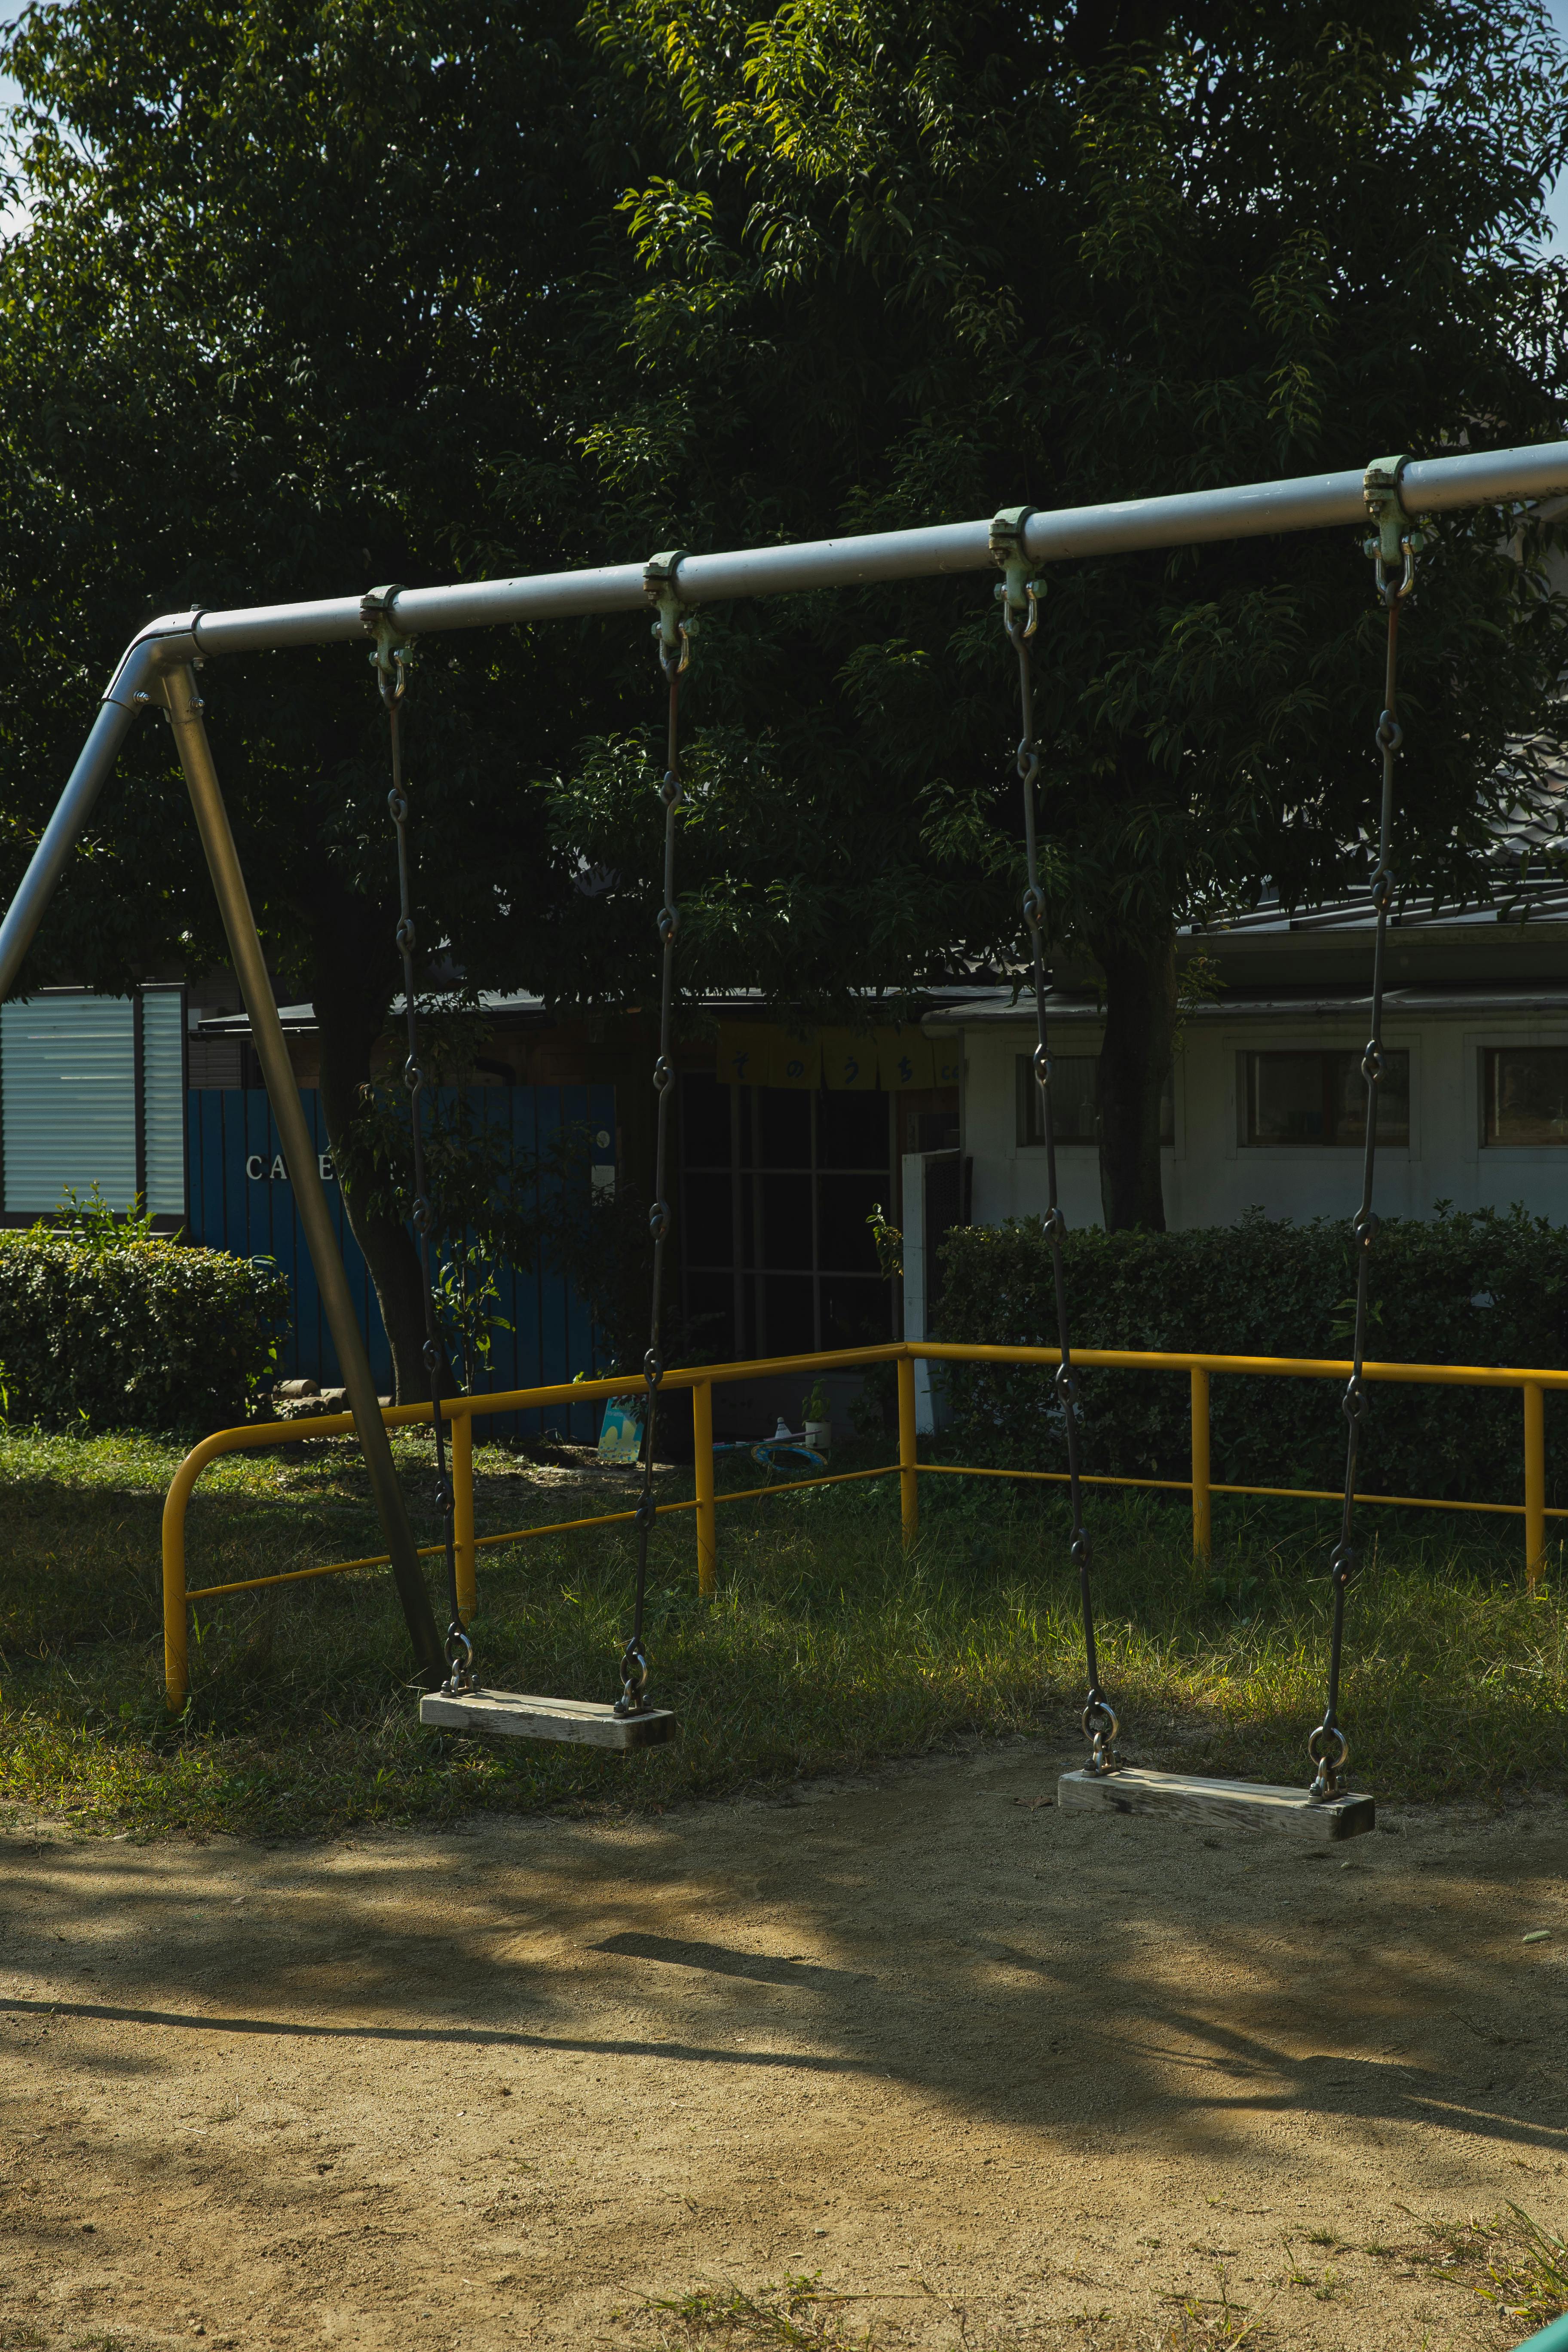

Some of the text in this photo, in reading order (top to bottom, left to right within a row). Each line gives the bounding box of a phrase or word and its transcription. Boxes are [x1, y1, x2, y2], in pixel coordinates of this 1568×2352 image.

[731, 1051, 913, 1084] そのうち
[246, 1155, 333, 1179] CAE
